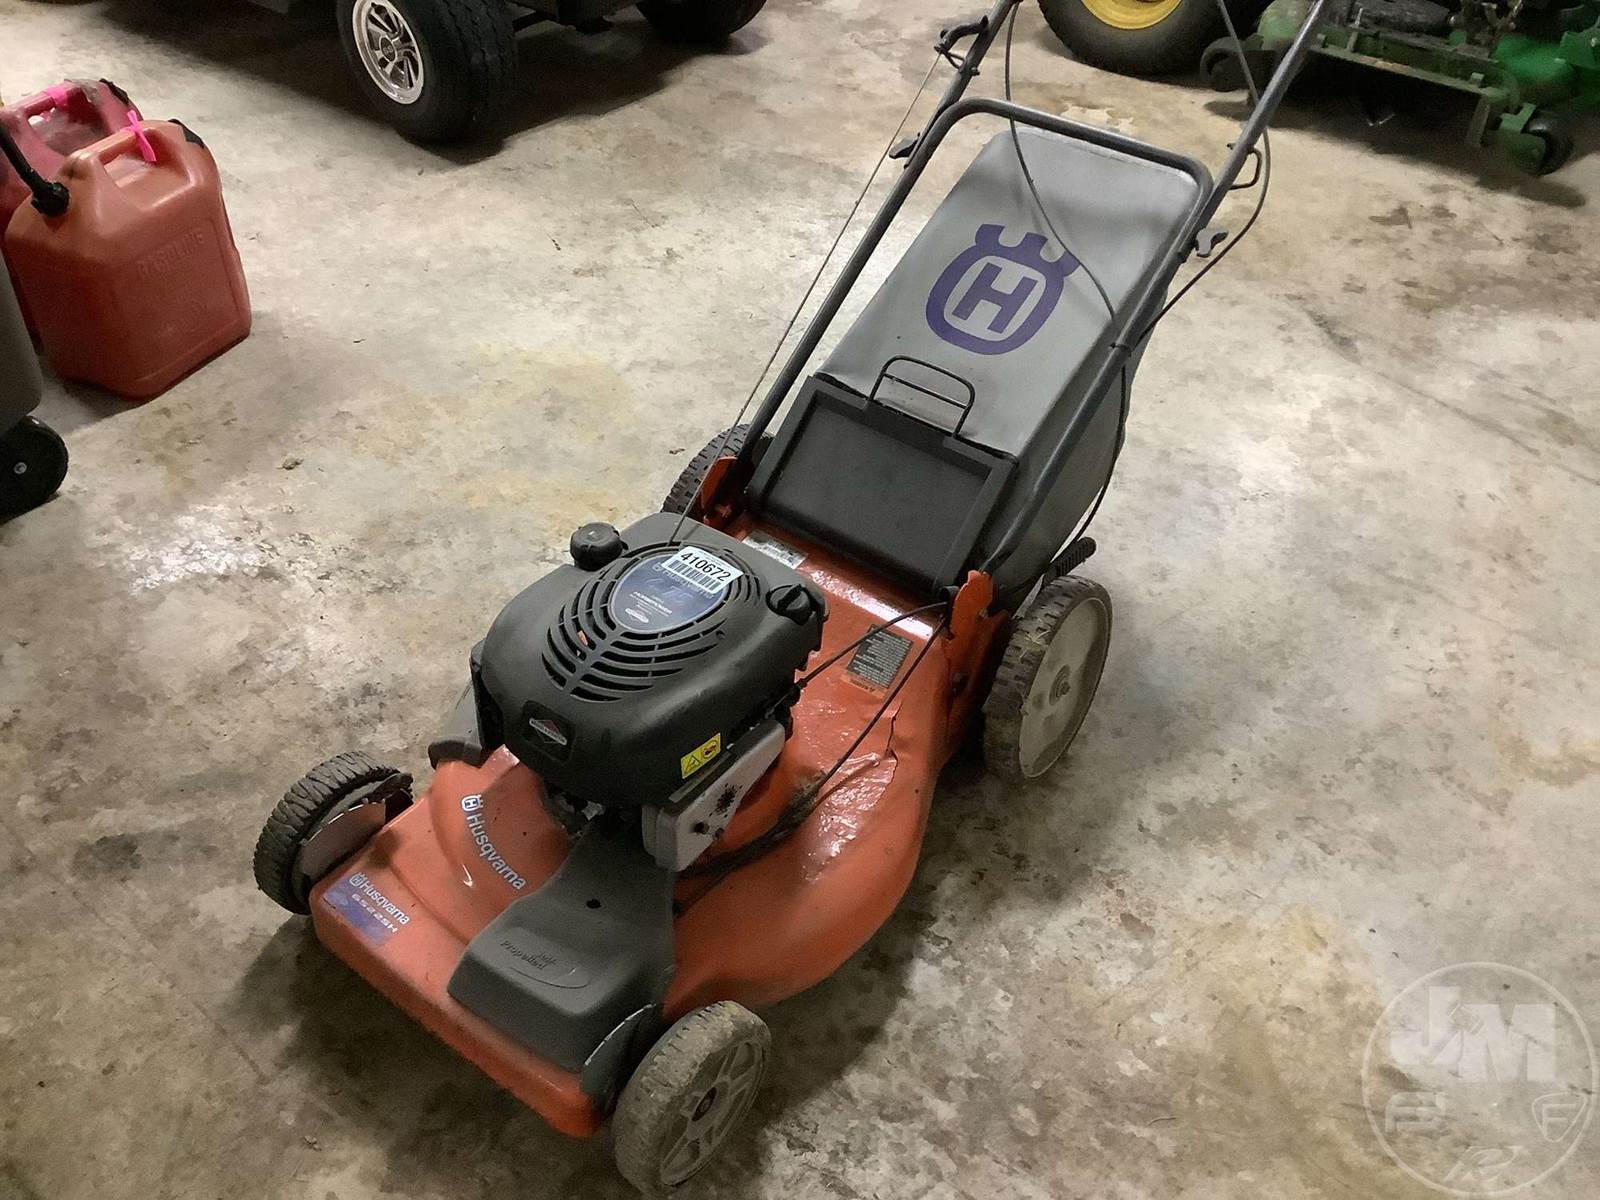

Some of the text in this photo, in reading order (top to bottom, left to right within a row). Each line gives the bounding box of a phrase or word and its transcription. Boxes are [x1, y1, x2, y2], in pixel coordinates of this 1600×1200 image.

[681, 552, 731, 582] 410672
[466, 813, 527, 890] Husqvarna
[359, 879, 411, 926] Husqvarna
